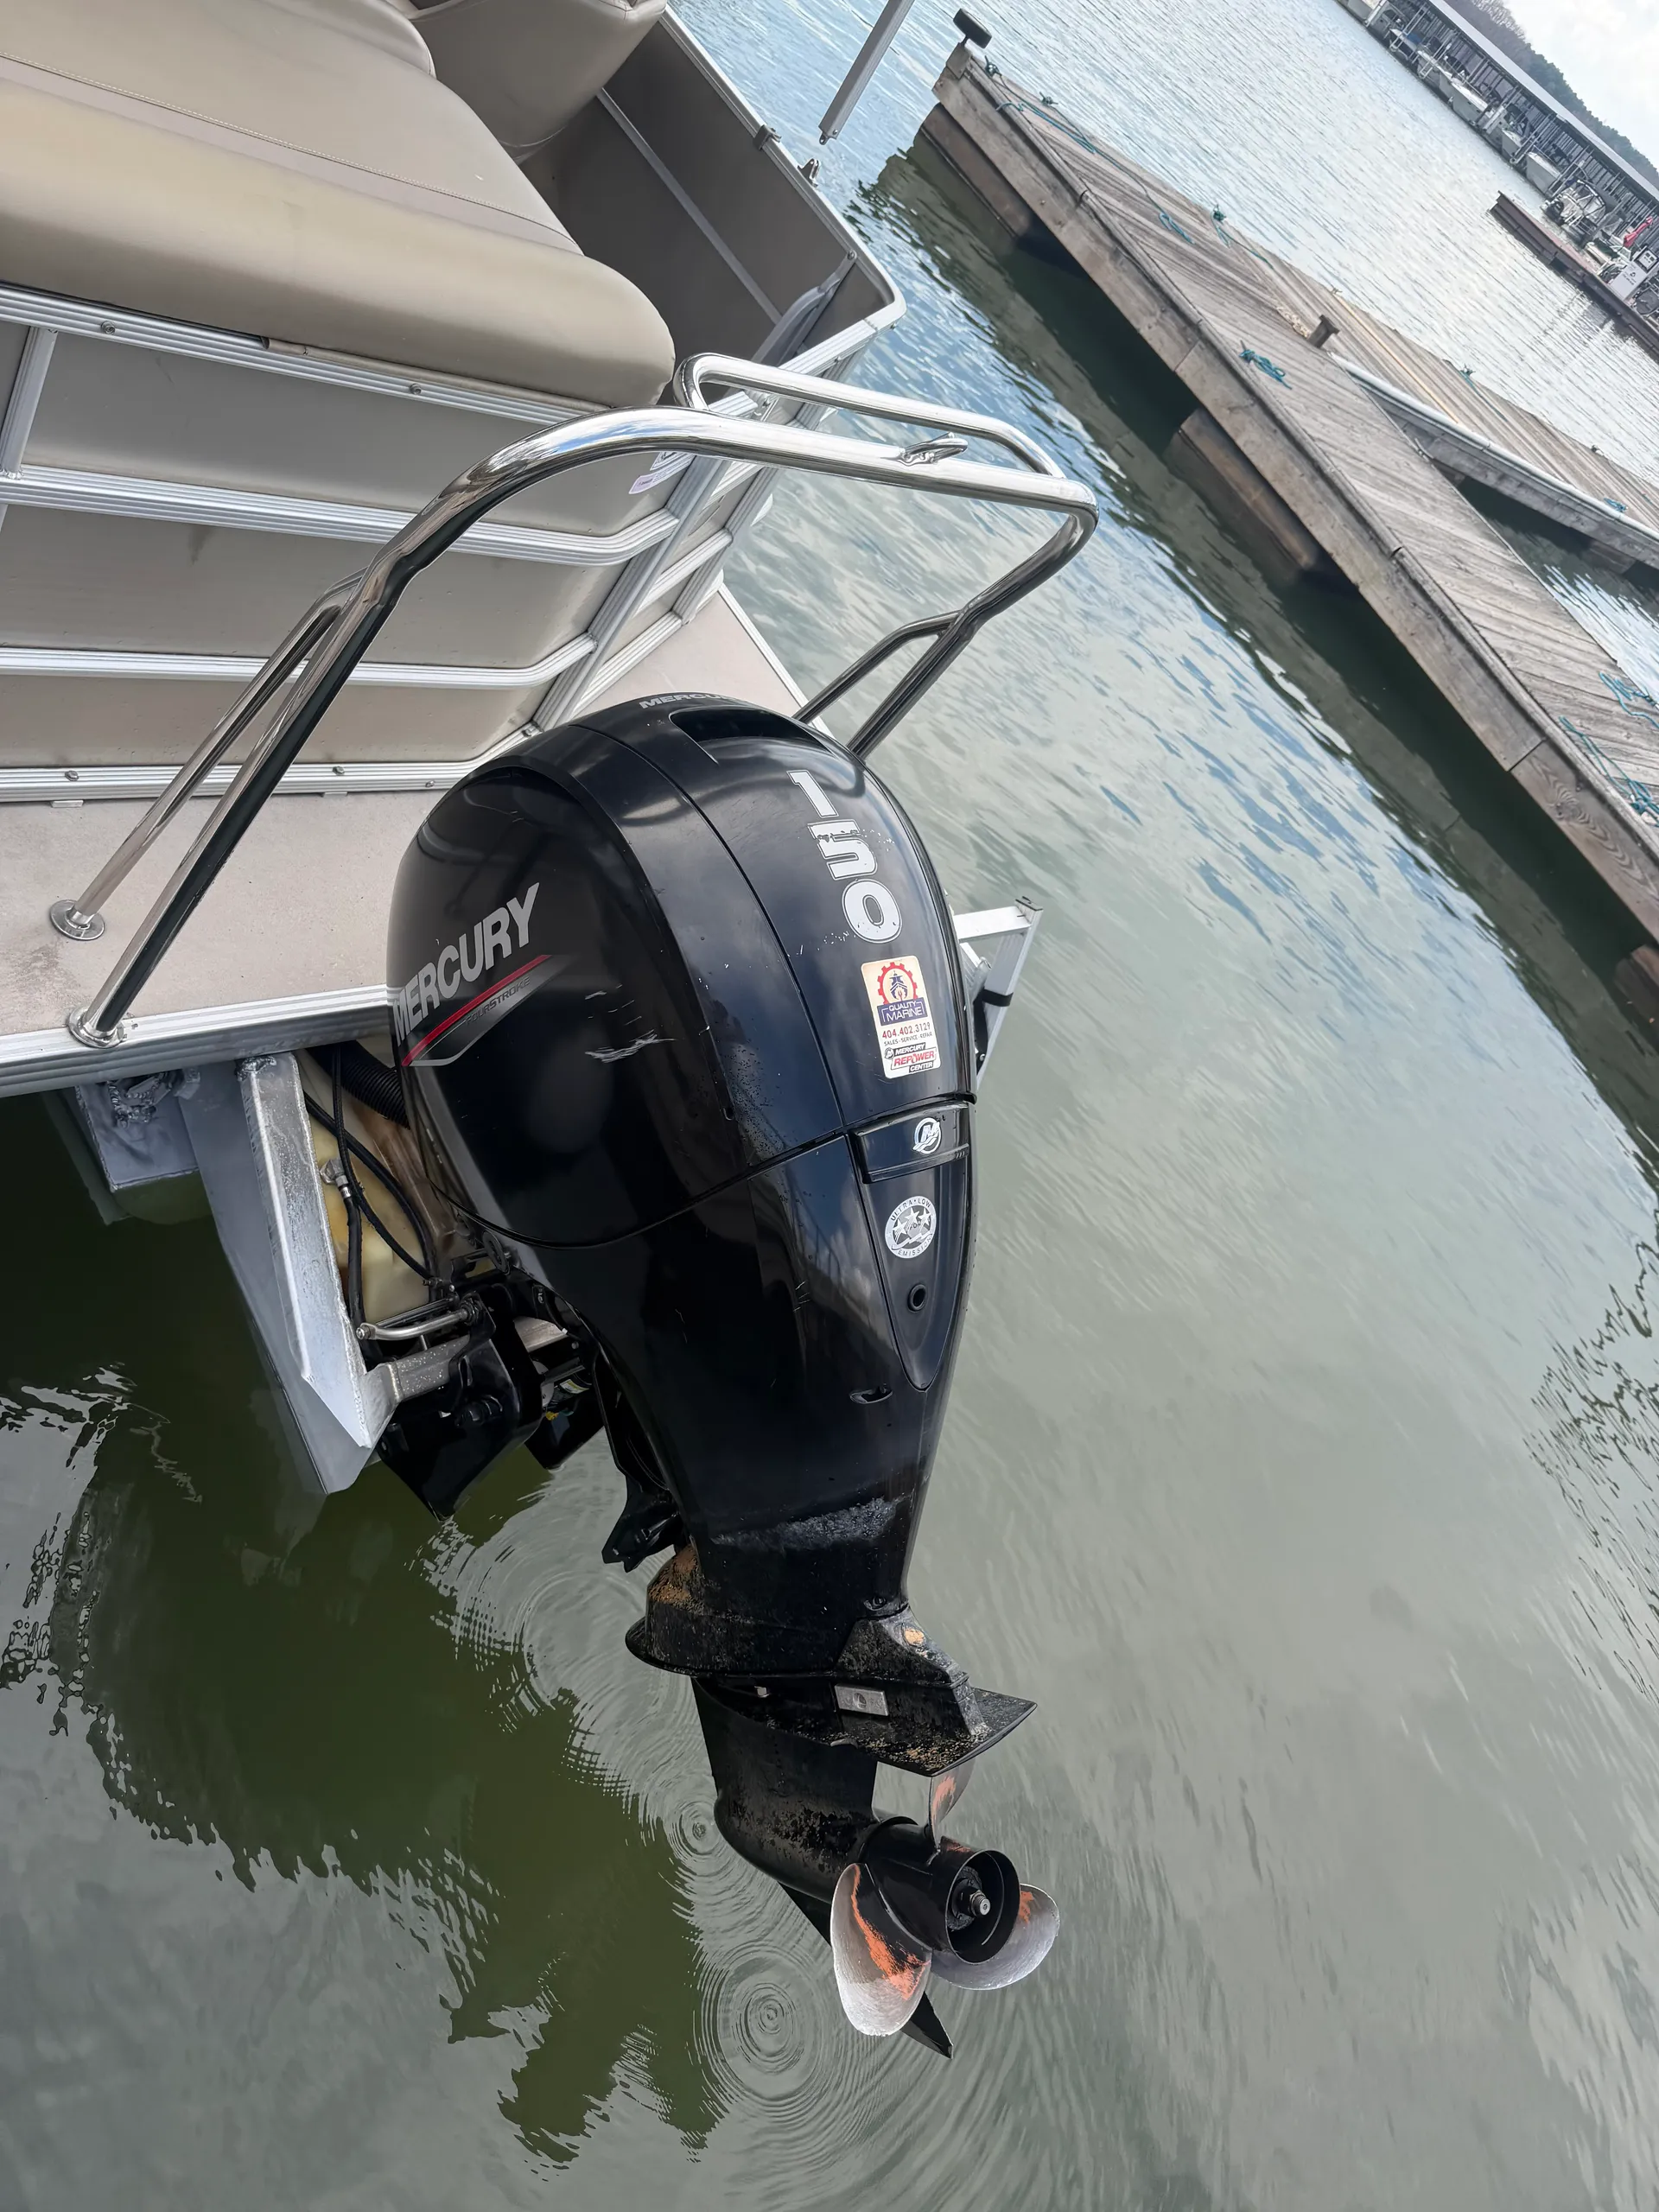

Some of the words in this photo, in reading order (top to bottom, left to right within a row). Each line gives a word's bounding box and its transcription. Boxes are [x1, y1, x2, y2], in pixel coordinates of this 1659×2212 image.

[639, 693, 734, 709] MERCU
[786, 769, 903, 944] 150
[392, 881, 540, 1047] MERCURY
[465, 976, 531, 1026] FOURSTROKE
[889, 1001, 917, 1011] QUALITY
[887, 1007, 923, 1021] MARINE
[882, 1021, 931, 1039] 404.402.3129
[901, 1034, 918, 1043] SERVICE
[895, 1044, 925, 1055] MERCURY
[894, 1050, 935, 1066] REPOWER
[910, 1063, 932, 1071] CENTER
[890, 1199, 913, 1222] ULTRA
[918, 1198, 931, 1208] LOW
[897, 1235, 933, 1256] EMISSION
